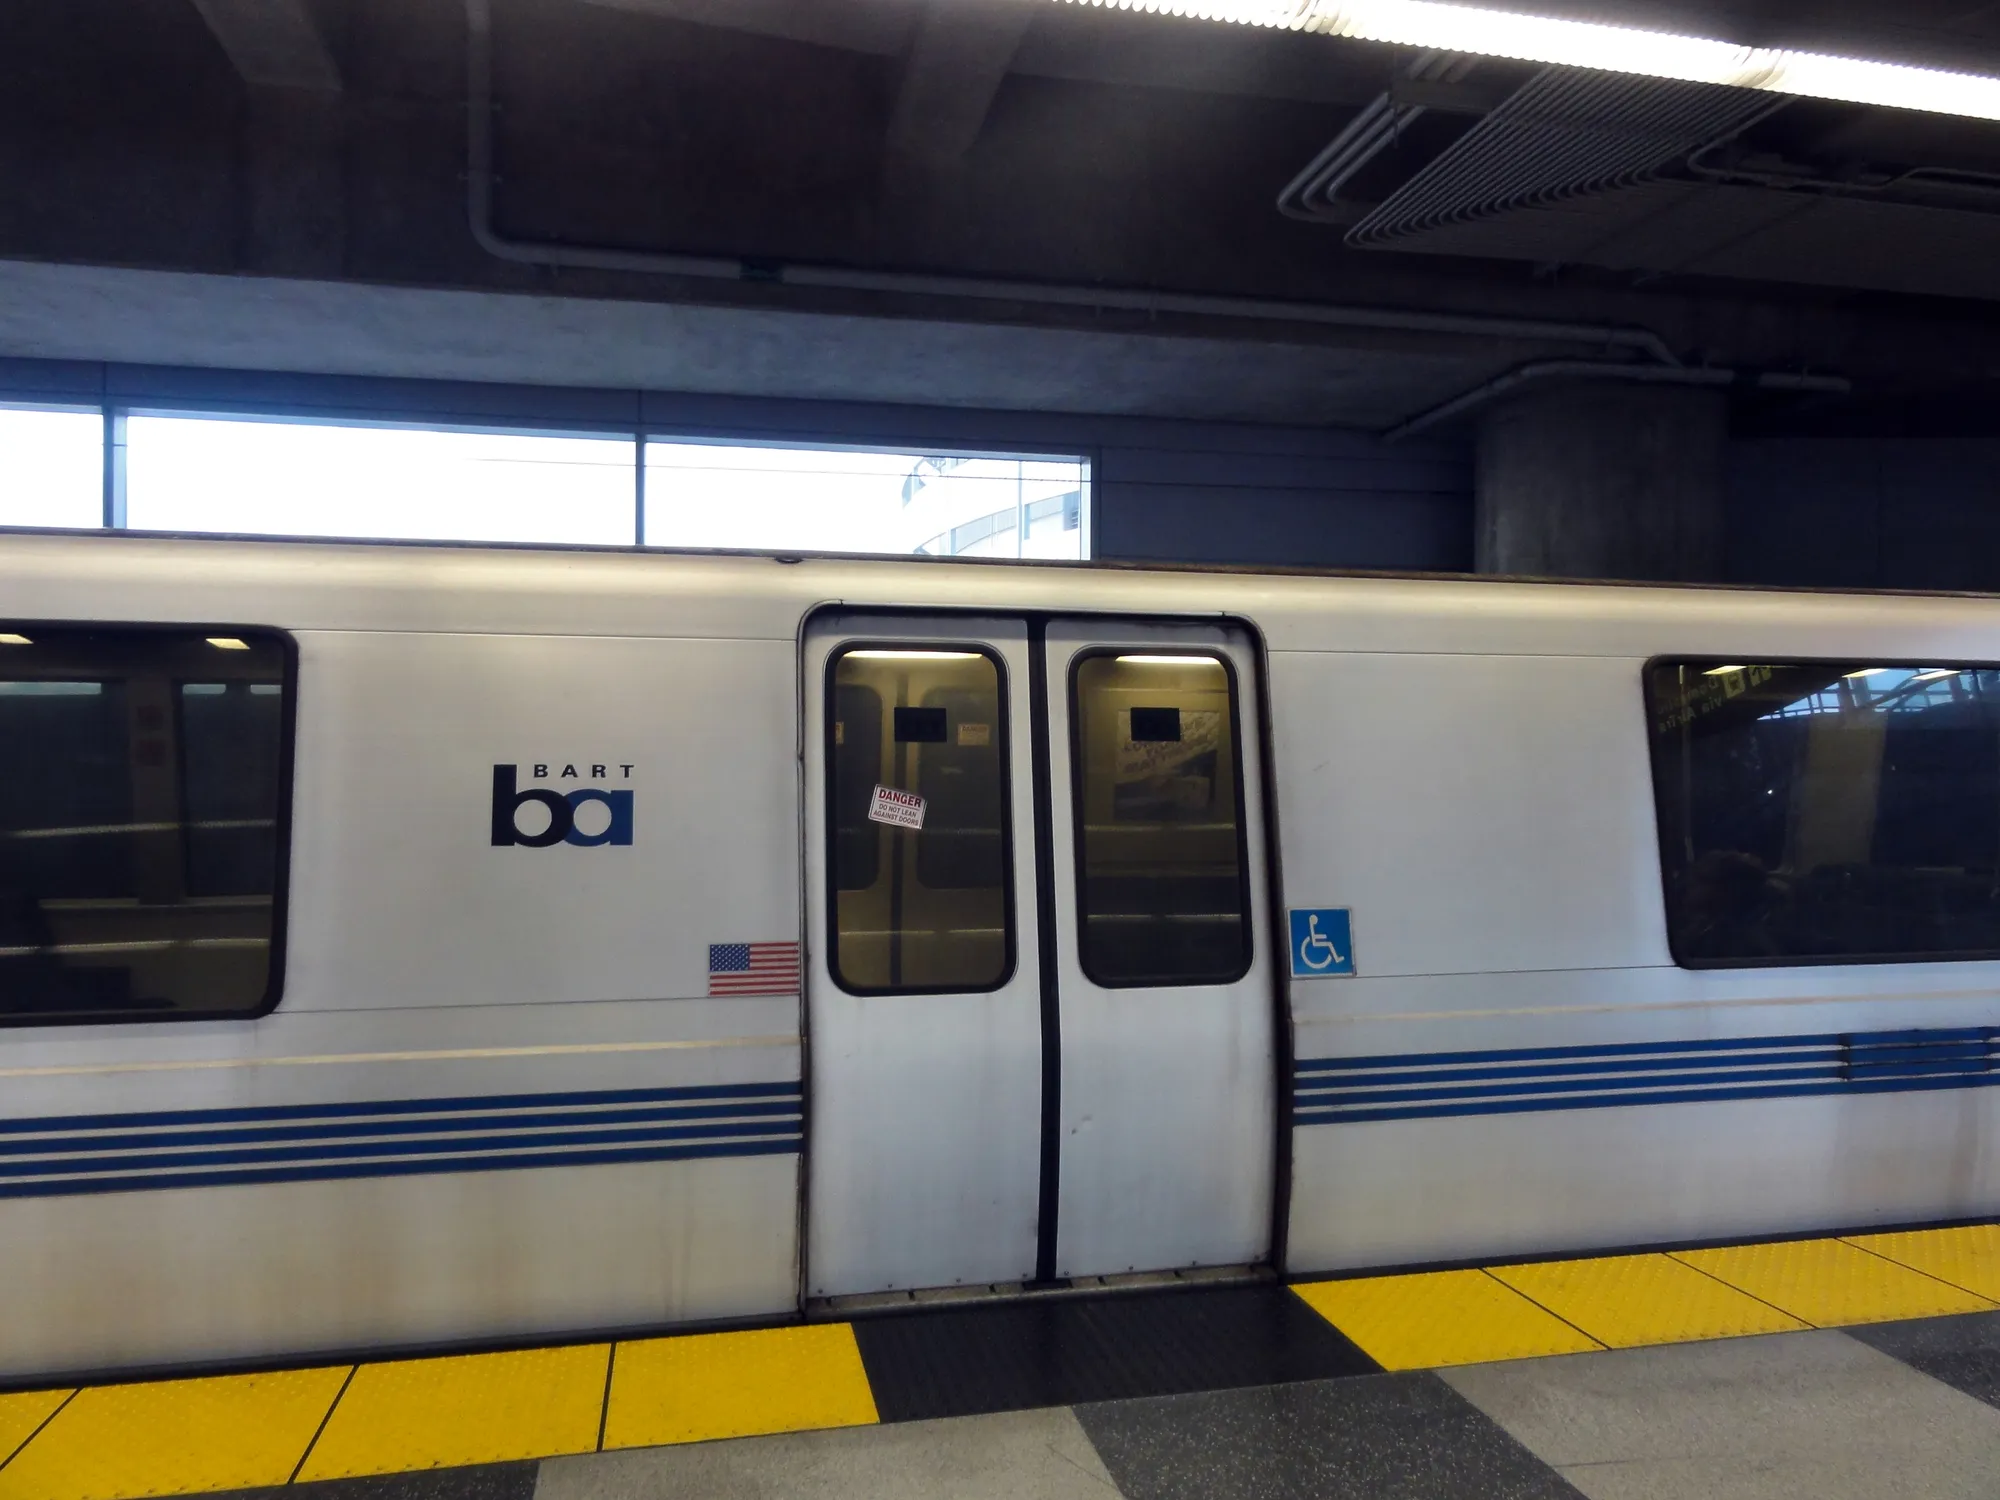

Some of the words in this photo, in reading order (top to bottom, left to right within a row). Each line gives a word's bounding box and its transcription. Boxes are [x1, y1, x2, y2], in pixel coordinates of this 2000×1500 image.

[533, 764, 635, 778] BART
[491, 764, 634, 847] ba
[879, 789, 921, 808] DANGER
[873, 810, 898, 821] AGAINST
[899, 815, 919, 826] DOORS
[888, 806, 900, 814] NOT
[902, 808, 917, 818] LEAN
